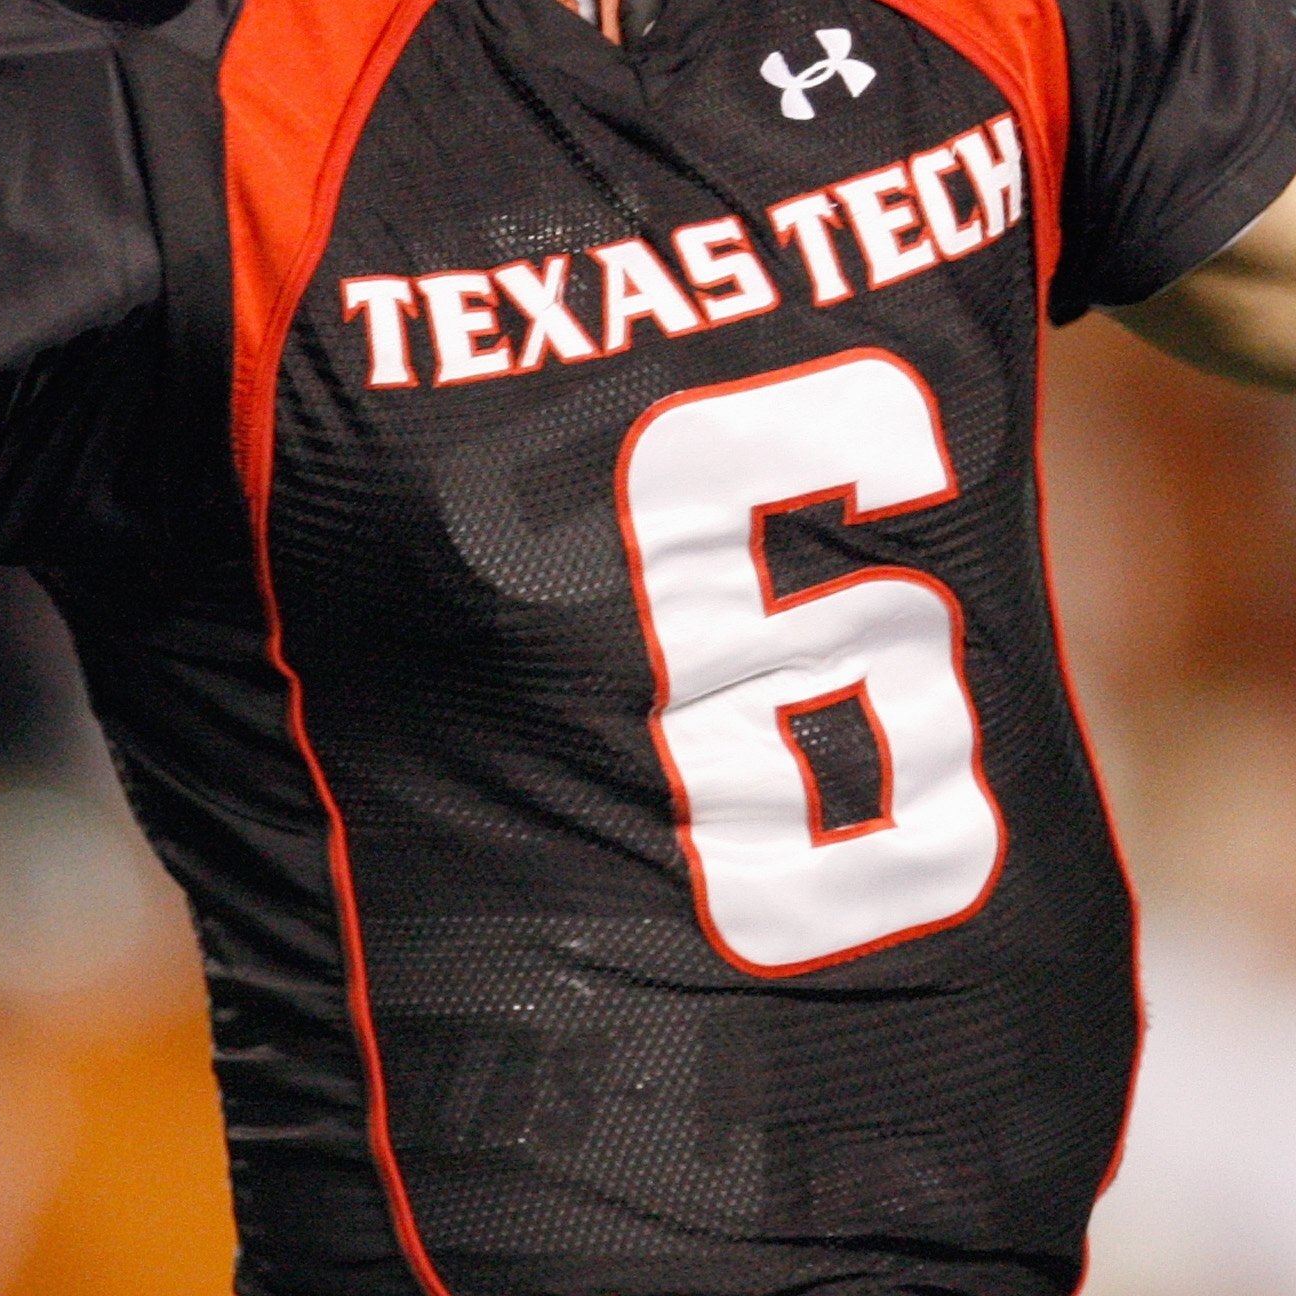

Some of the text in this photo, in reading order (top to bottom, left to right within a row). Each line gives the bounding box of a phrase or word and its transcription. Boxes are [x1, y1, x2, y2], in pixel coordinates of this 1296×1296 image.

[340, 112, 1029, 389] TEXAS TECH
[613, 345, 1009, 979] 6
